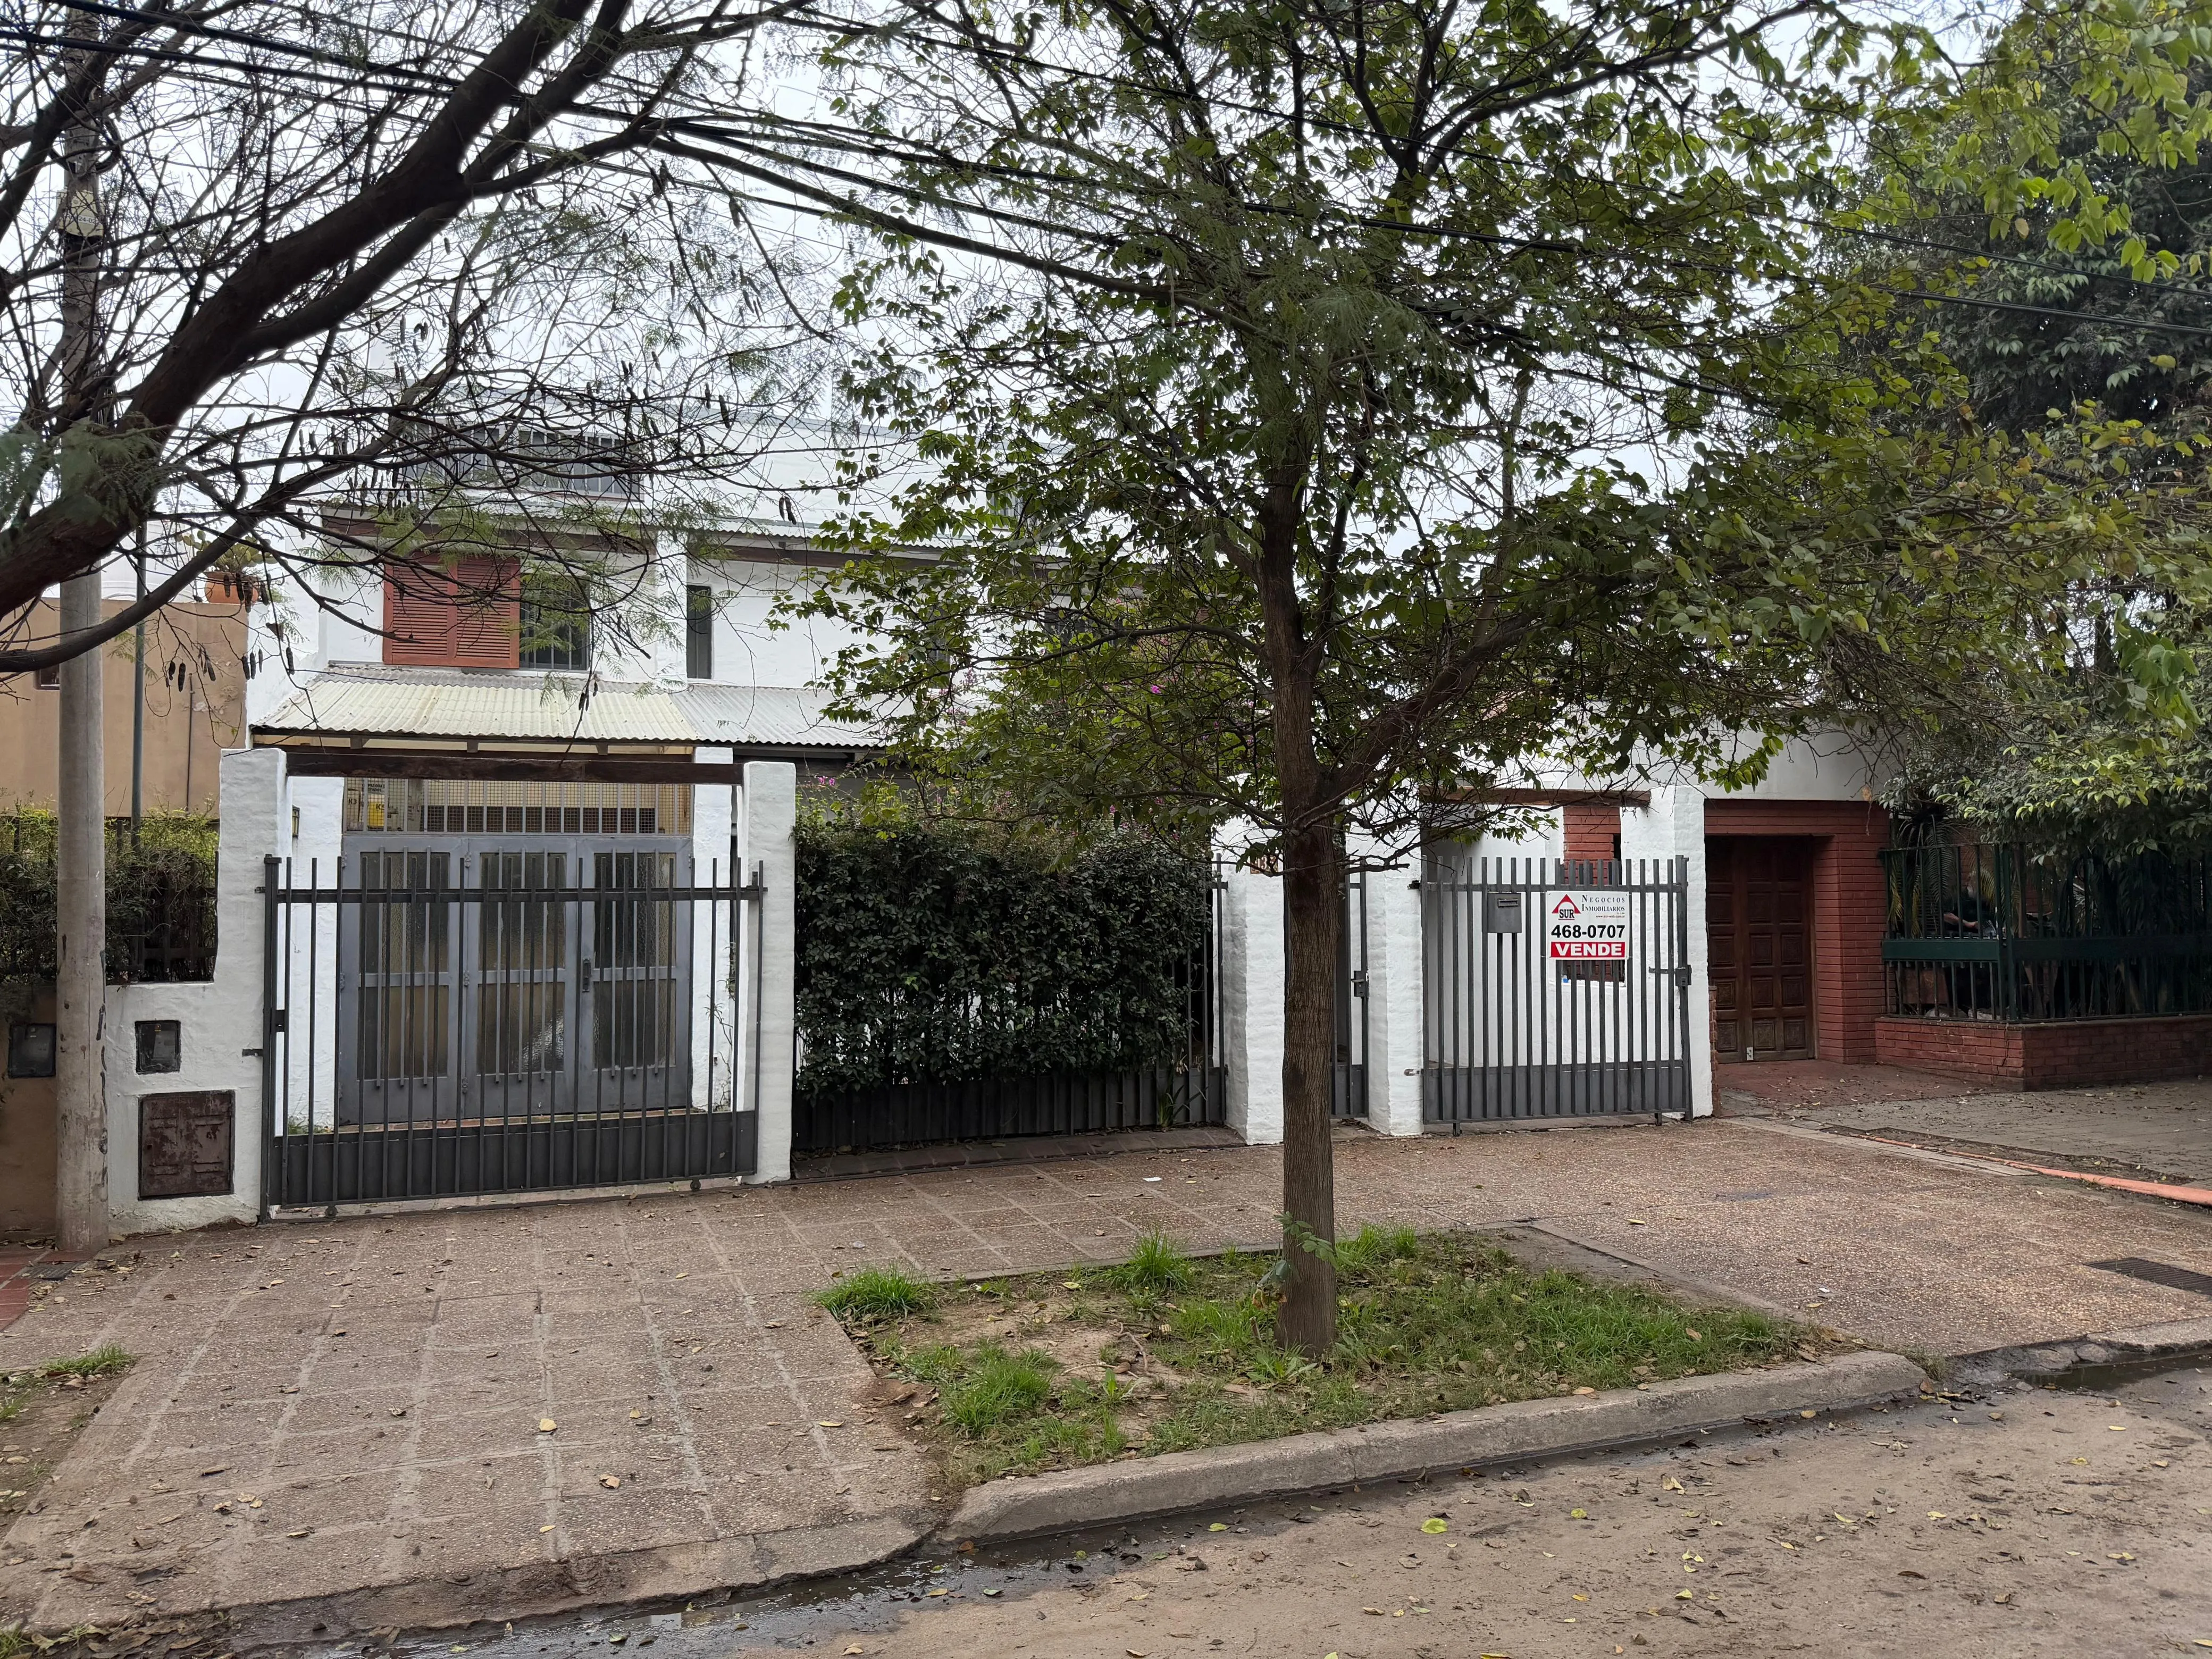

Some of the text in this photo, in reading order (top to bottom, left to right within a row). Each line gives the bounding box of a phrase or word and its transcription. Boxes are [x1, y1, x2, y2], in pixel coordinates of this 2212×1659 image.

[1559, 909, 1575, 918] SUR
[1551, 925, 1626, 938] 468-0707
[1555, 943, 1622, 956] VENDE
